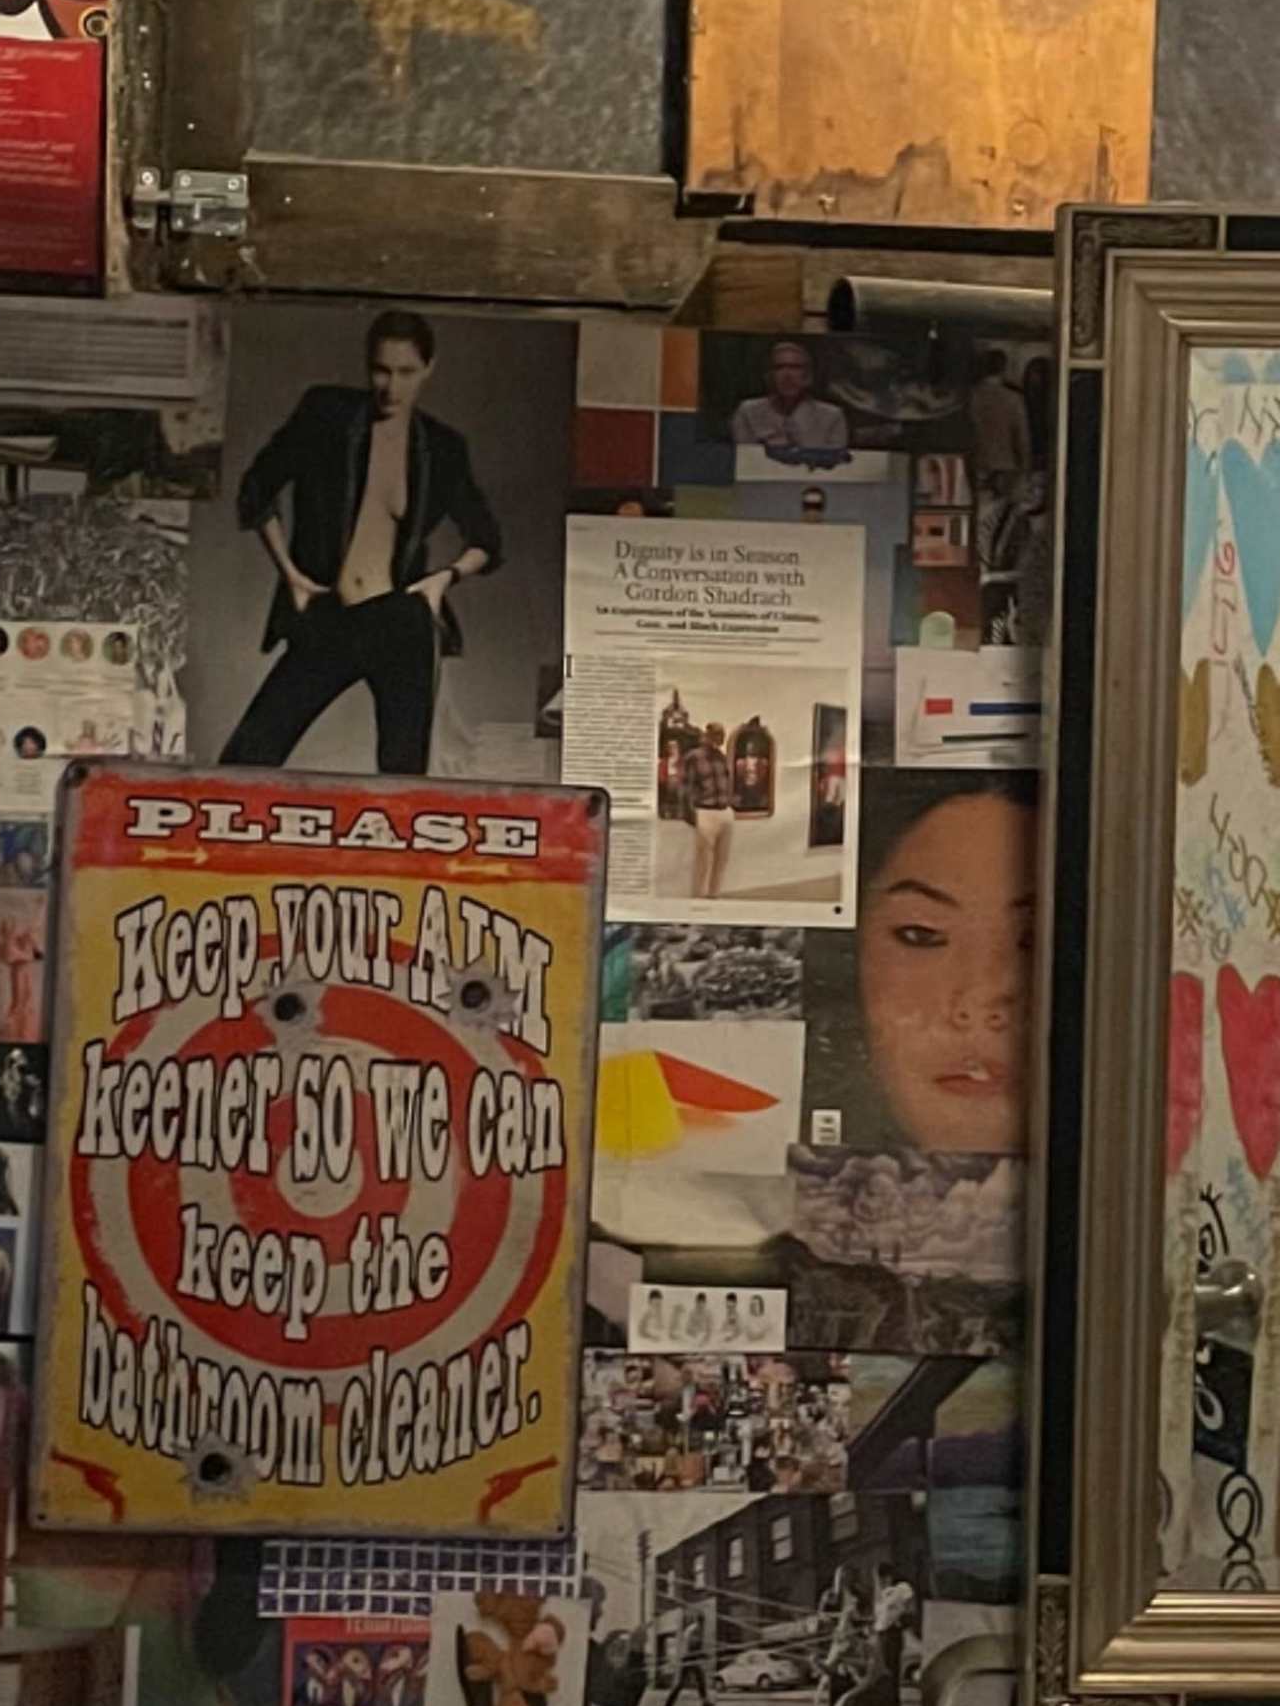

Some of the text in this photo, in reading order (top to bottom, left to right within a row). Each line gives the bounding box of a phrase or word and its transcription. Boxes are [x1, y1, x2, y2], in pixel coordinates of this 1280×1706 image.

[613, 562, 806, 588] A Conversation with
[615, 540, 800, 565] Dignity is in Season
[624, 583, 793, 607] Gordon Shadrach
[125, 798, 540, 857] PLEASE
[113, 883, 553, 1056] Keep your AIM
[78, 1037, 565, 1184] keener so we can
[176, 1202, 453, 1341] keep the
[79, 1282, 542, 1487] bathroom cleaner.
